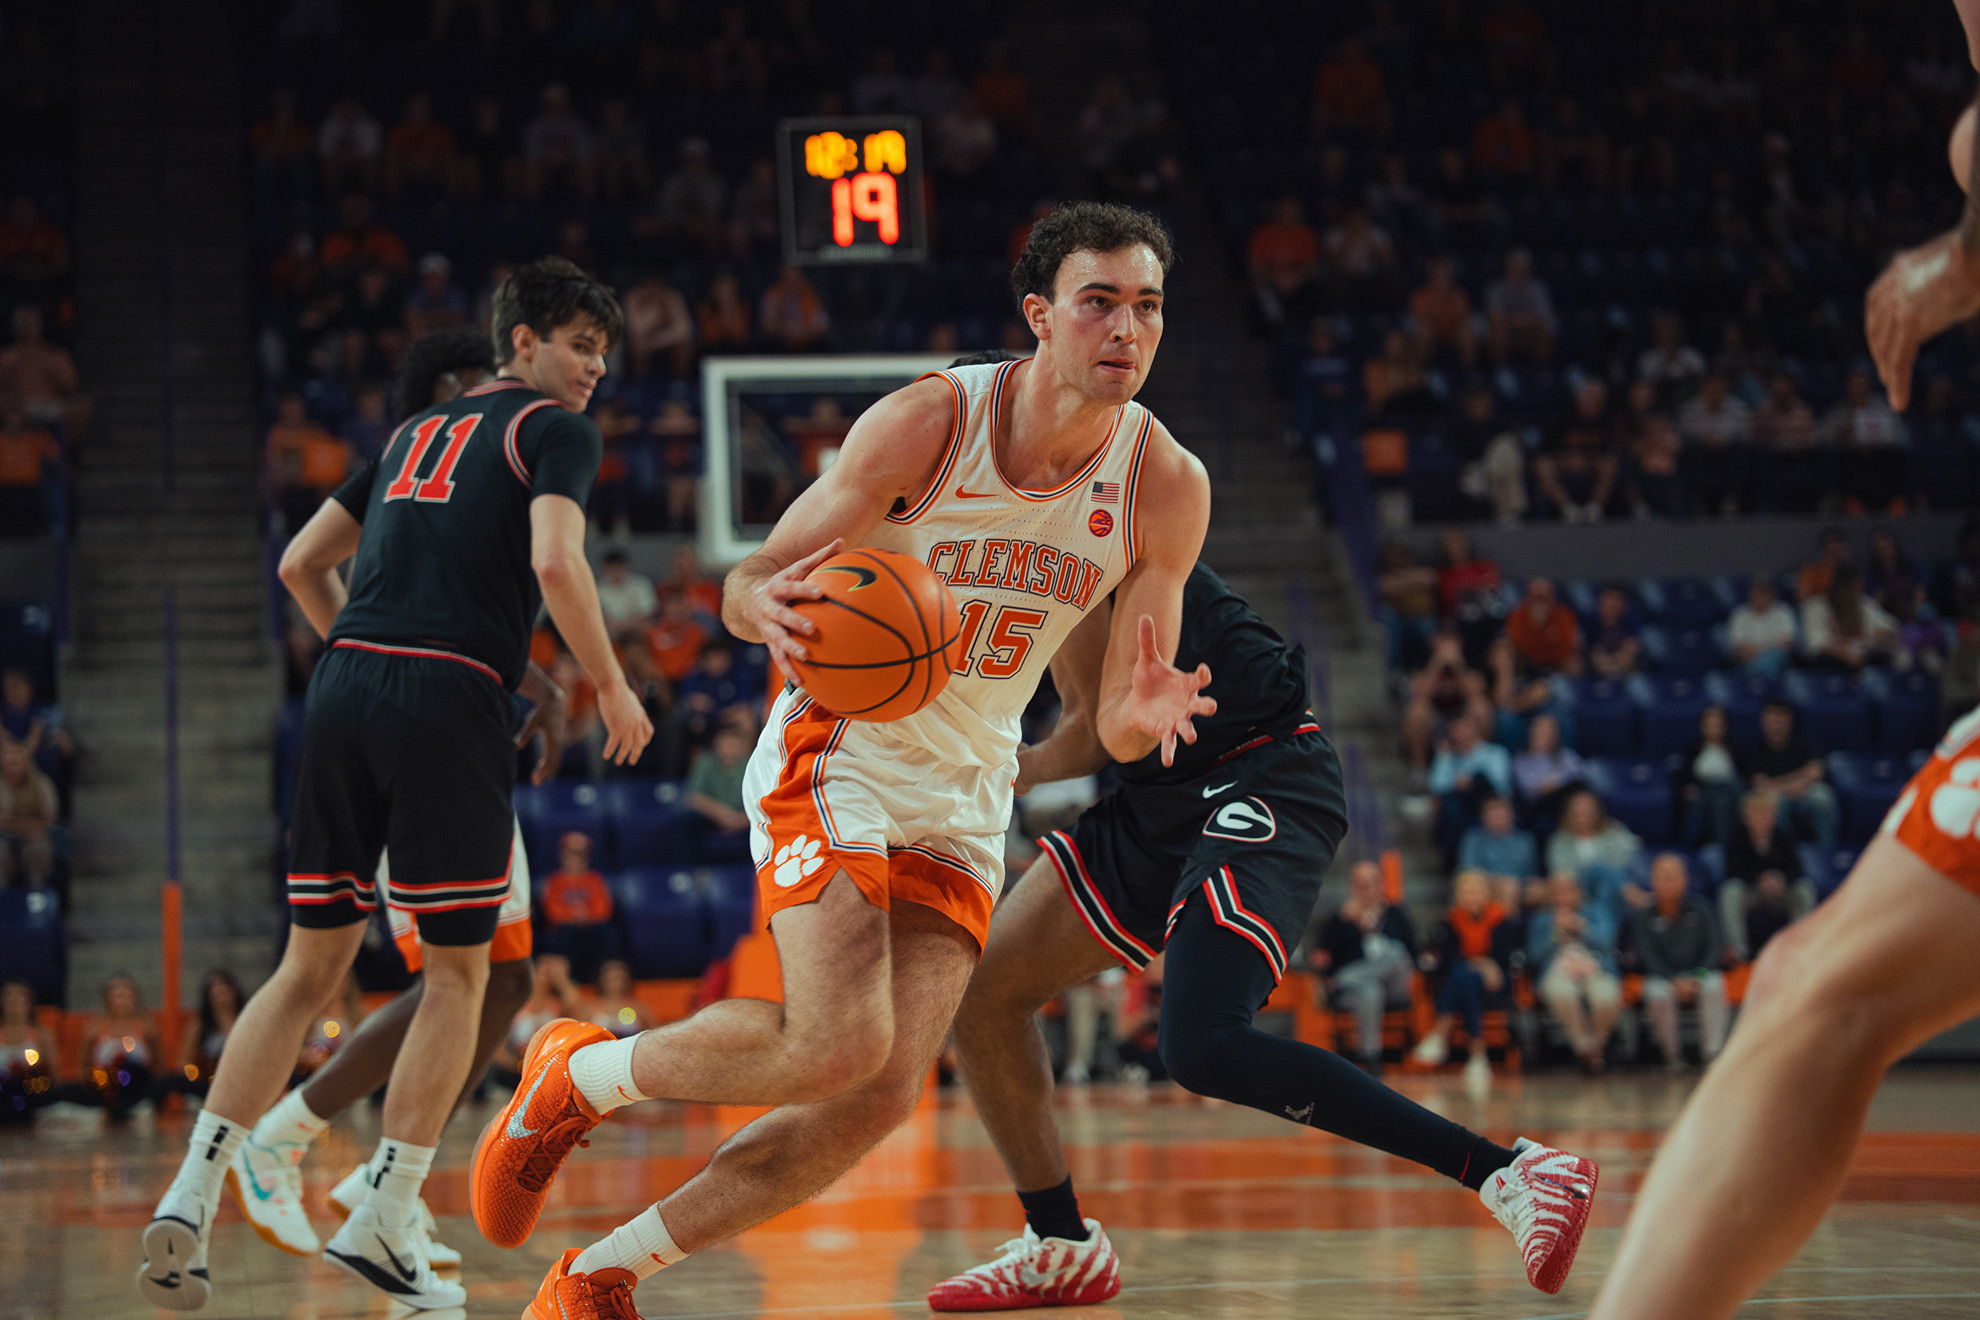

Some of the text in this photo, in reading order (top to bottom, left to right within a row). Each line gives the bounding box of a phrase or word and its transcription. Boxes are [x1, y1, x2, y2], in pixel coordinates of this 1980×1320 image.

[832, 172, 899, 247] 19
[383, 414, 484, 503] 11
[1092, 518, 1112, 526] ACC
[927, 539, 1104, 611] CLEMSON
[953, 599, 1048, 679] 15
